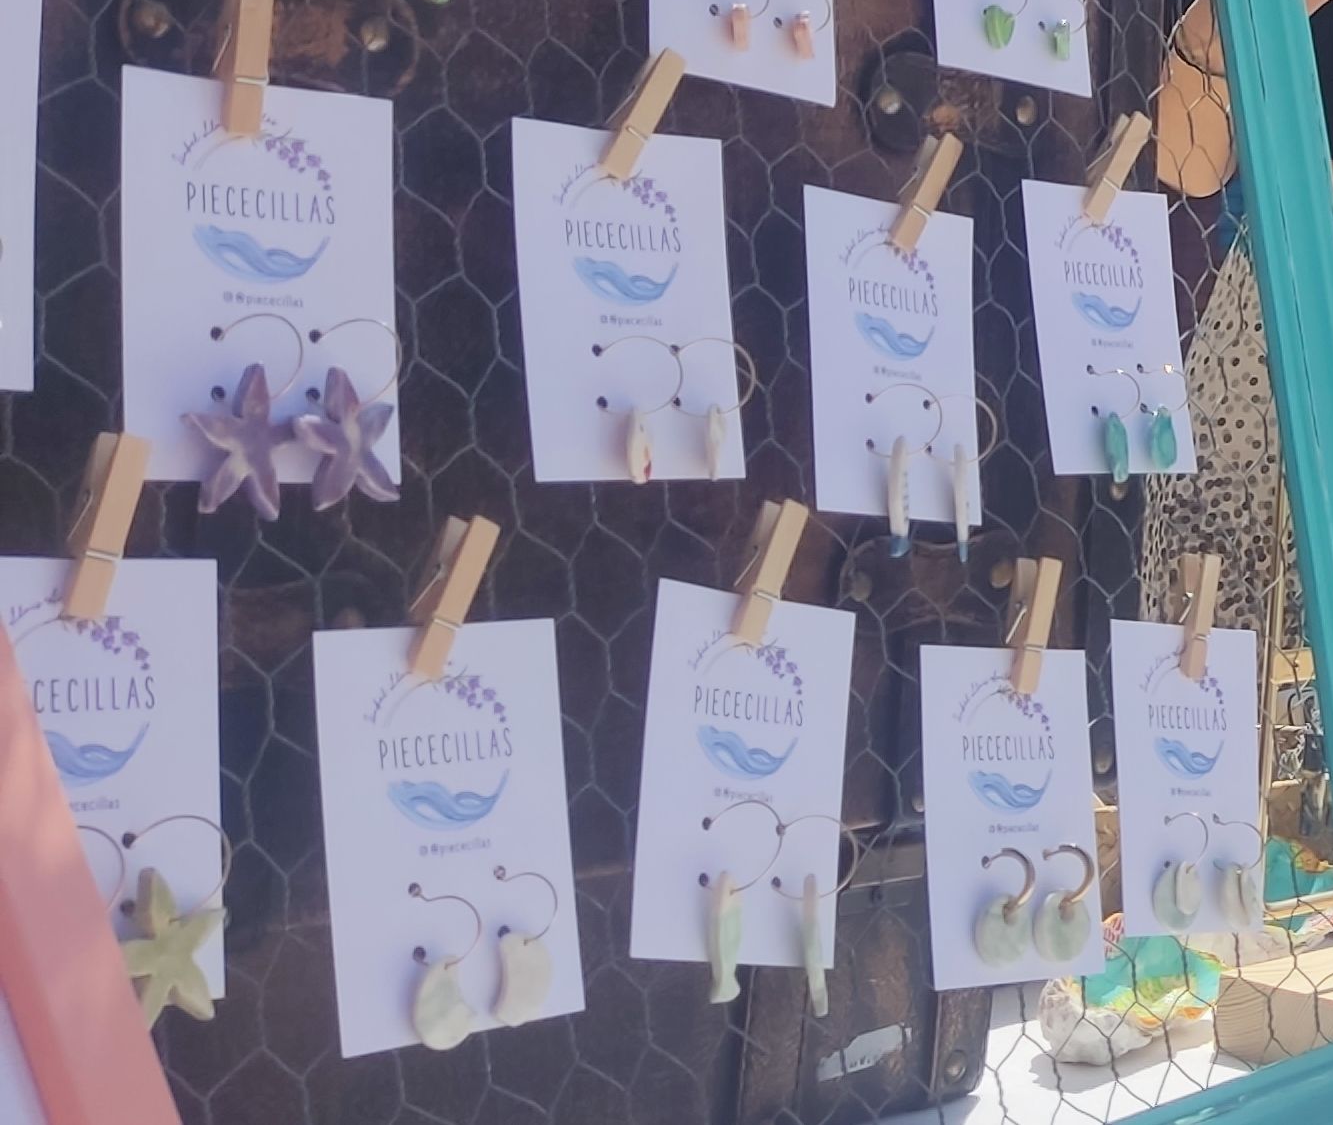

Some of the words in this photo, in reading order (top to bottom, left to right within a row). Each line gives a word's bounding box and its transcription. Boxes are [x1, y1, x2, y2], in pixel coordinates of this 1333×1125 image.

[186, 182, 335, 225] PIECECILLAS
[565, 219, 681, 253] PIECECILLAS
[1064, 261, 1143, 289] PIECECILLAS
[849, 277, 938, 317] PIECECILLAS
[33, 676, 156, 714] CECILLAS
[694, 685, 804, 727] PIECECILLAS
[1148, 704, 1227, 731] PIECECILLAS
[379, 727, 513, 770] PIECECILLAS
[962, 735, 1055, 761] PIECECILLAS
